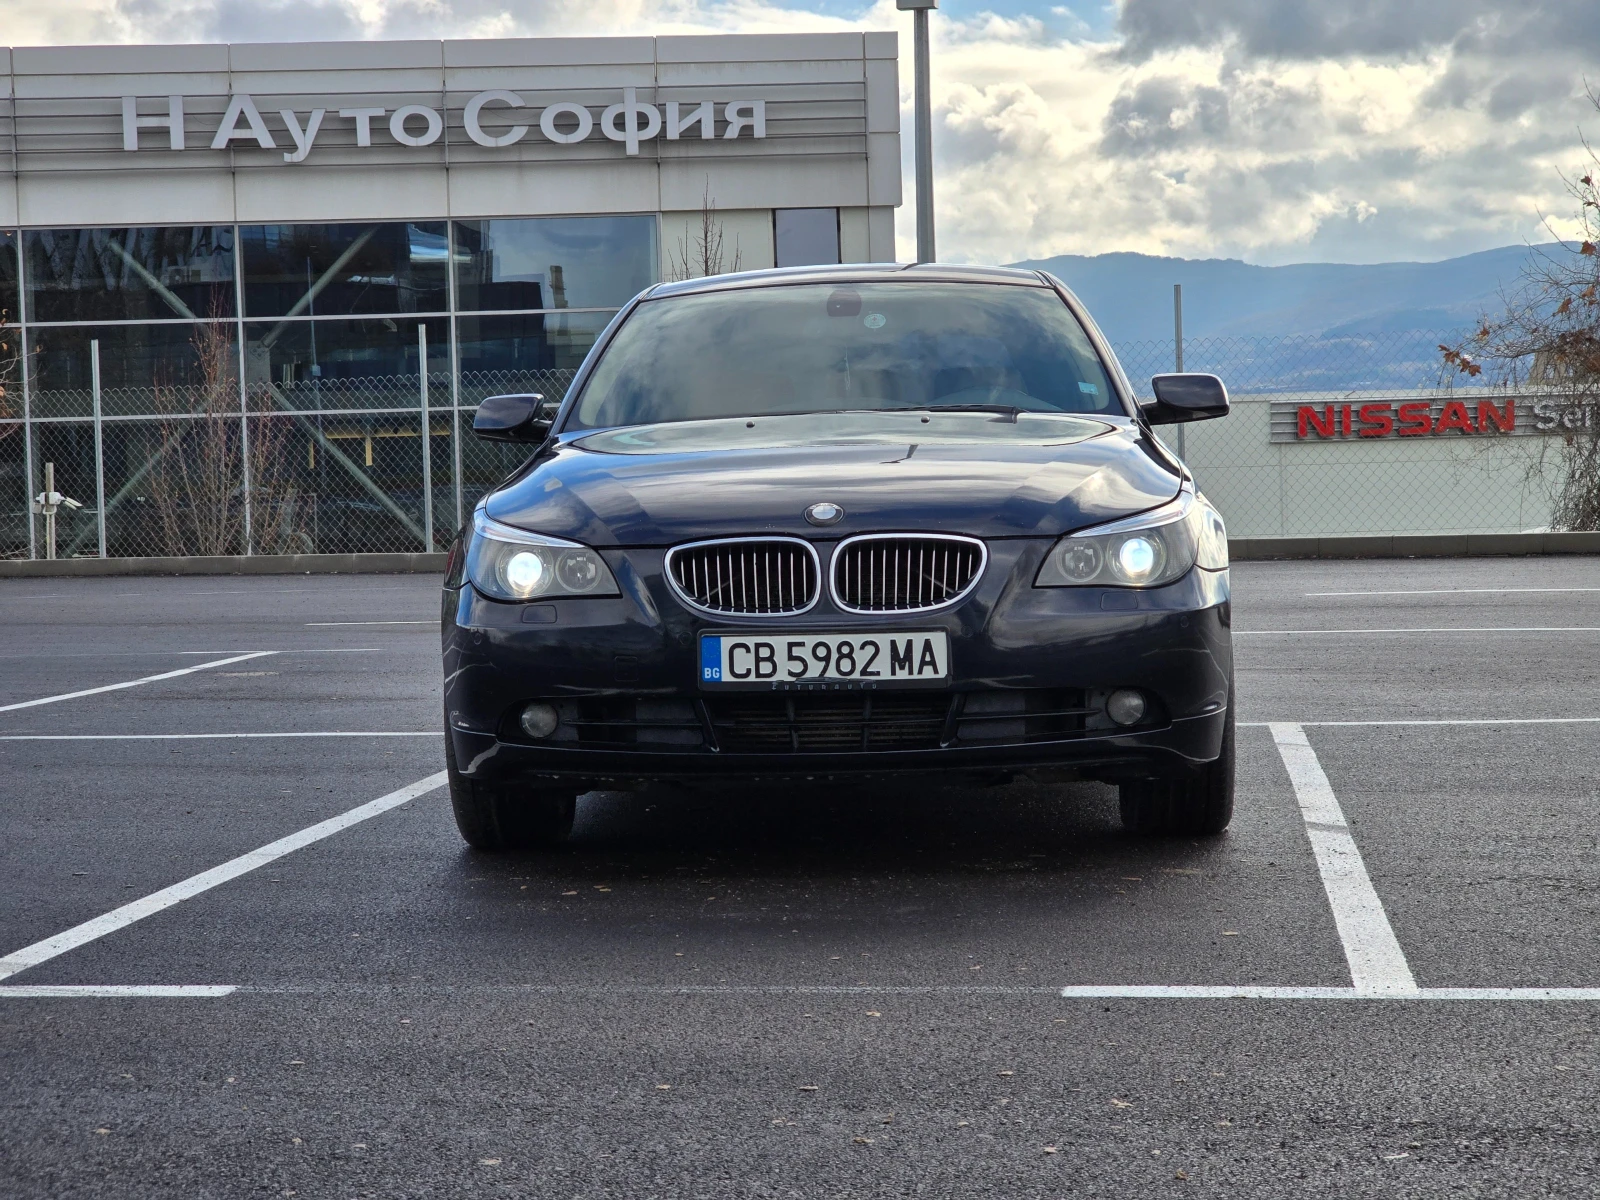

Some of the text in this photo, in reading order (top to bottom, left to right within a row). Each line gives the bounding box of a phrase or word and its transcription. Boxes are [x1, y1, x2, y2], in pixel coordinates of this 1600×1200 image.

[1296, 399, 1516, 438] NISSAN
[704, 667, 720, 679] BG
[728, 638, 940, 679] CB 5982 MA
